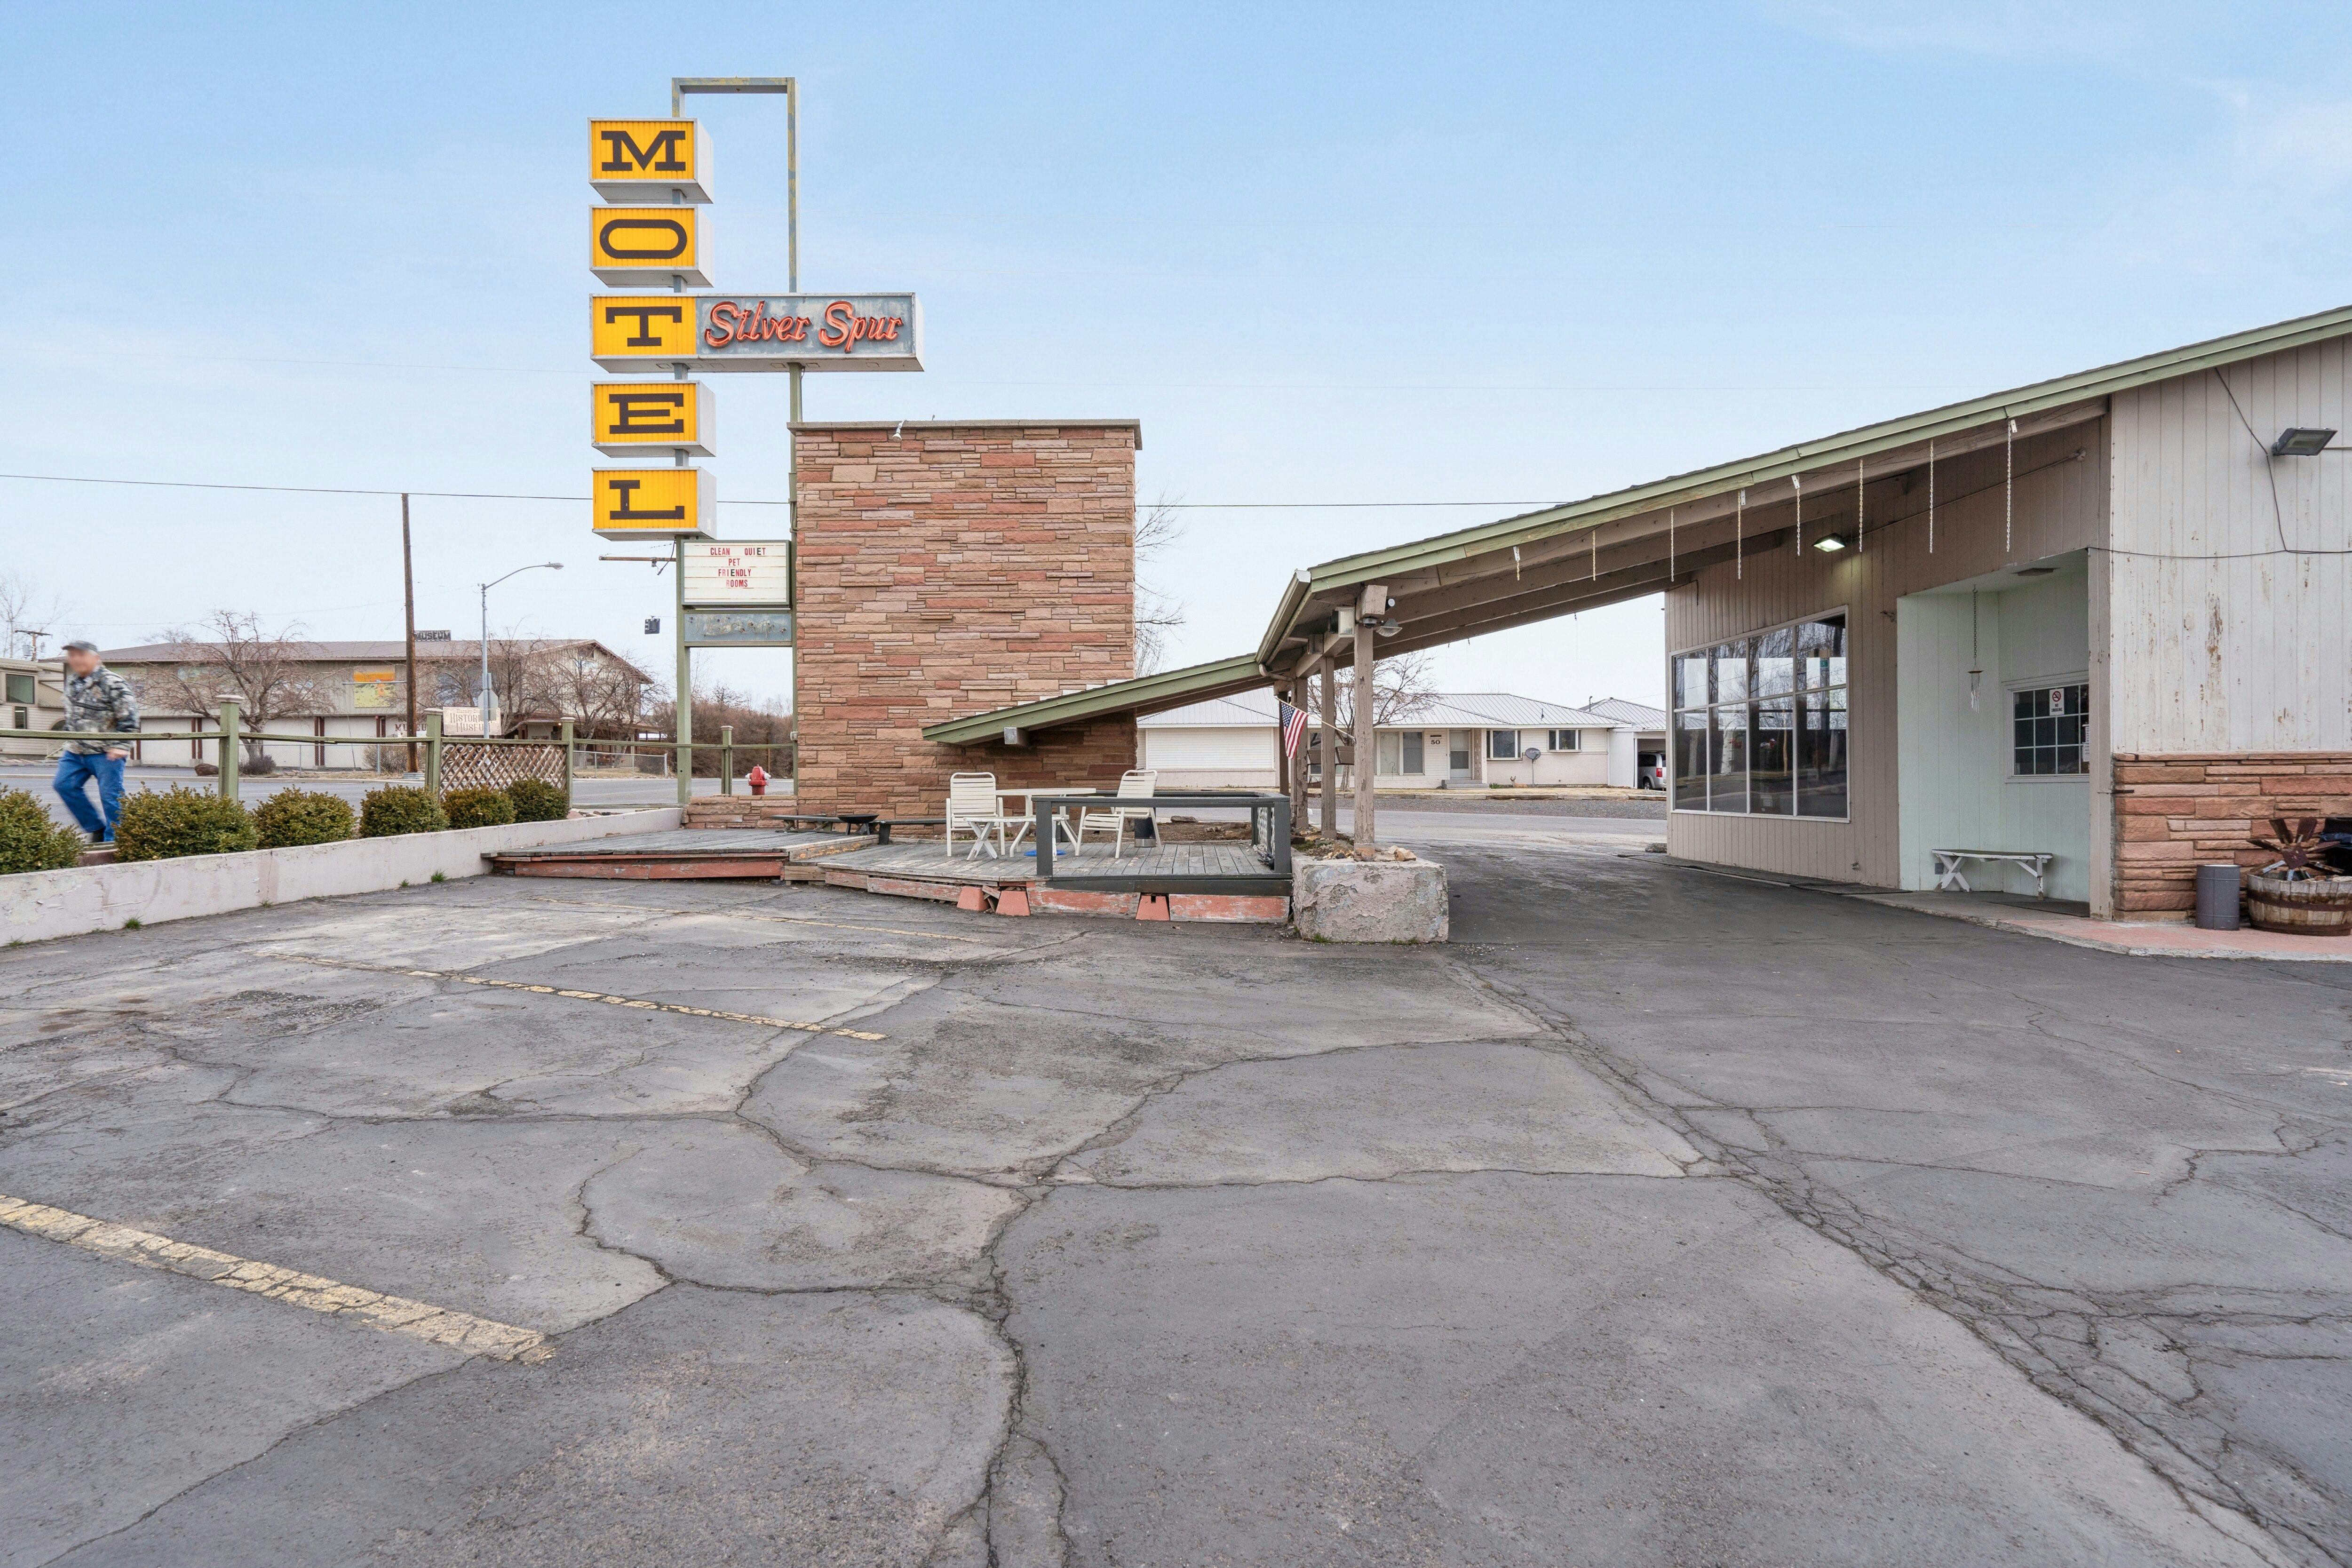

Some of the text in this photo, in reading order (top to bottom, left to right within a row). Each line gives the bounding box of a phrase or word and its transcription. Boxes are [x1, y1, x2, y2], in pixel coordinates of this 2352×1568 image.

[600, 130, 687, 520] MOTEL
[704, 300, 903, 353] Silver Spur
